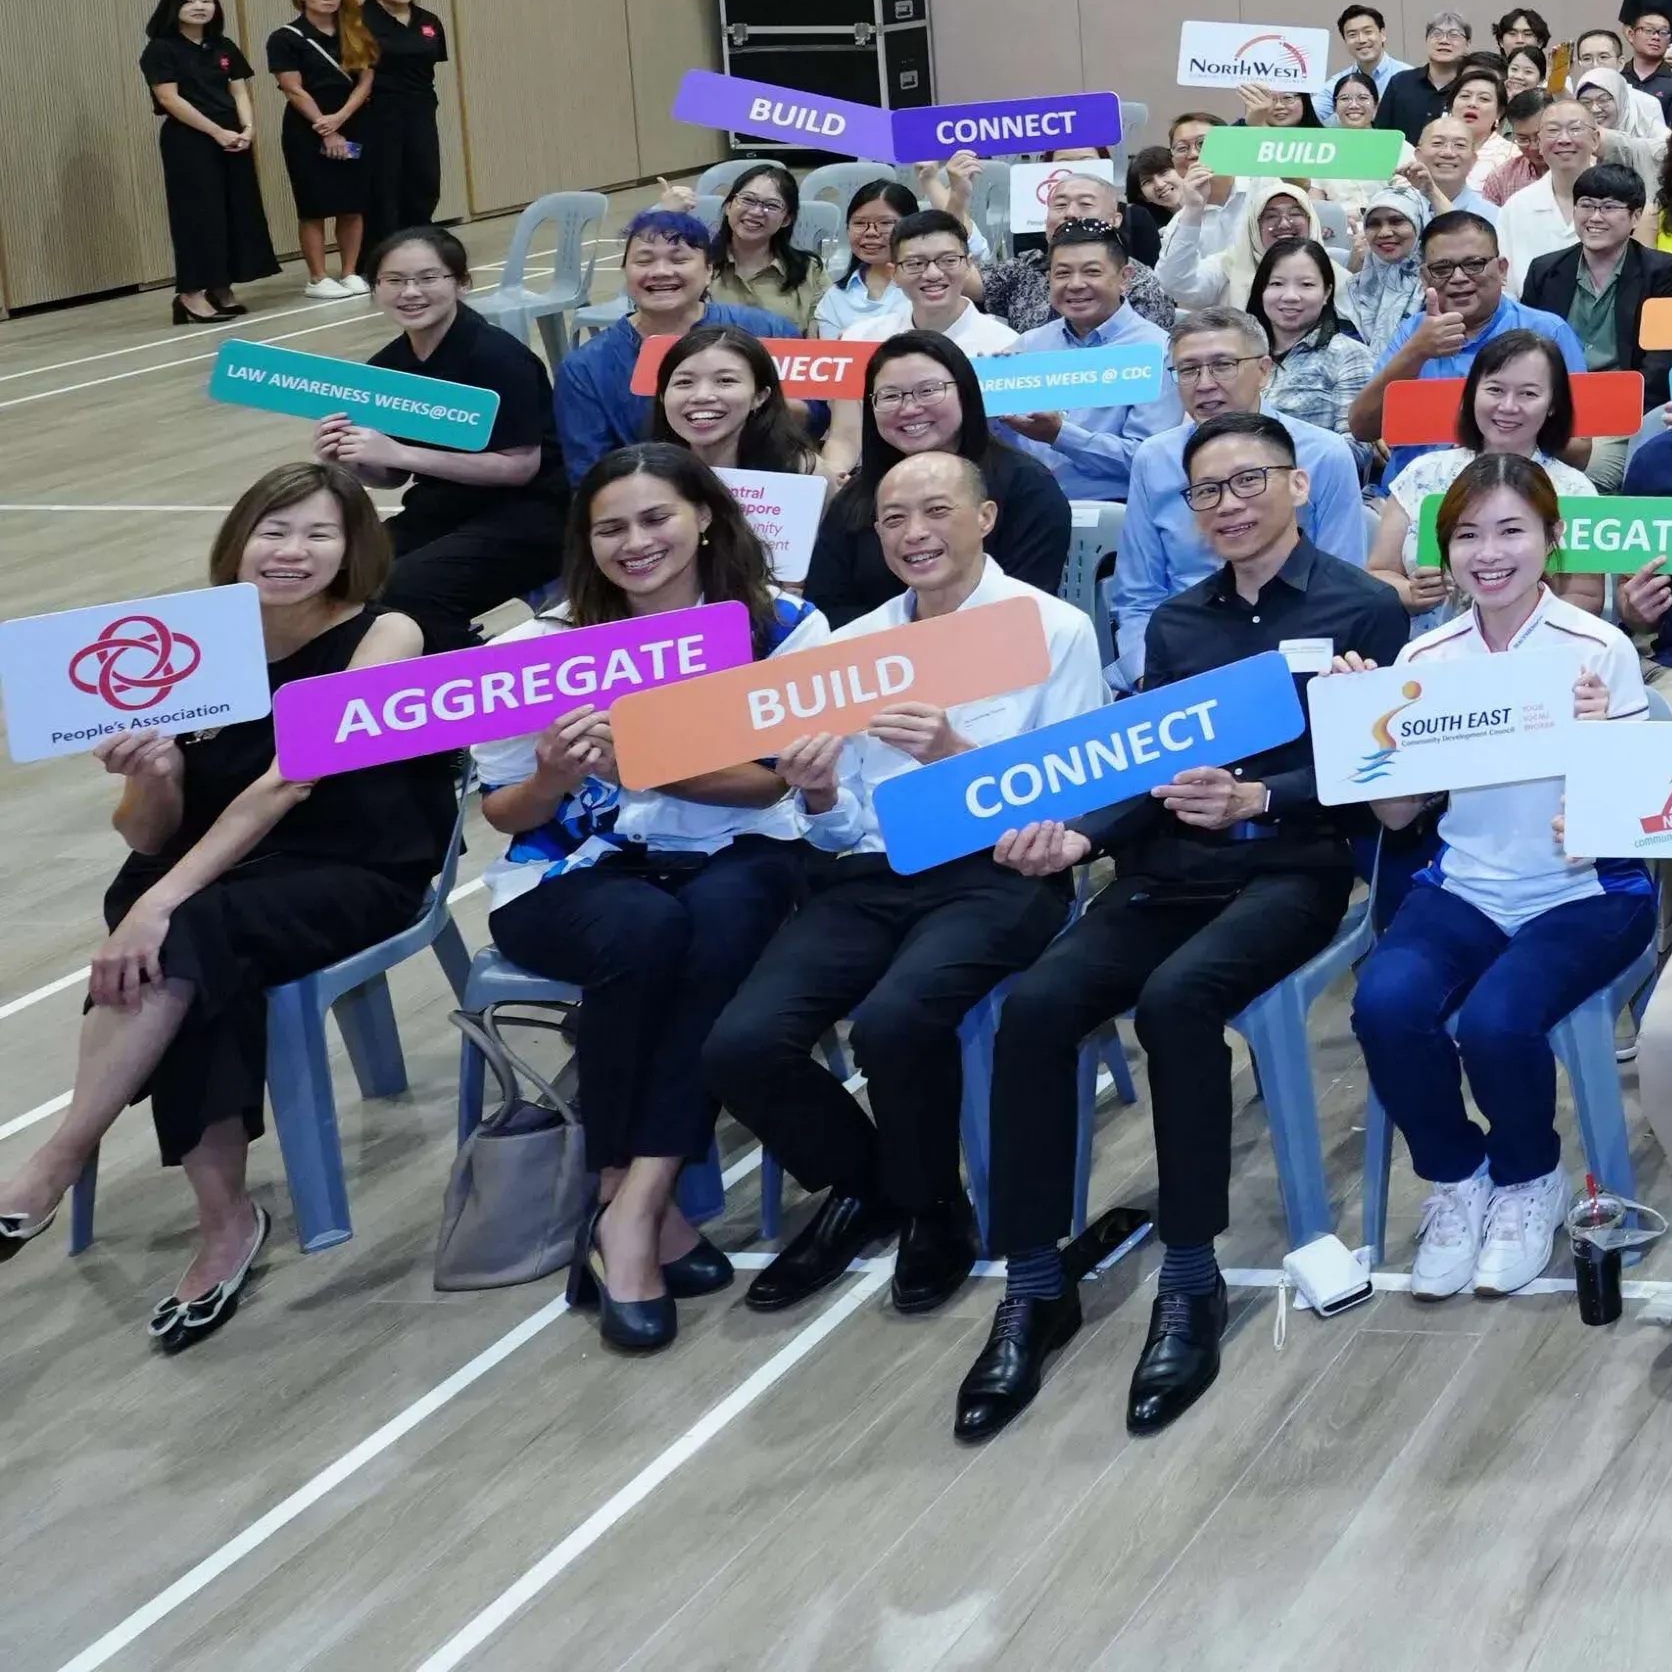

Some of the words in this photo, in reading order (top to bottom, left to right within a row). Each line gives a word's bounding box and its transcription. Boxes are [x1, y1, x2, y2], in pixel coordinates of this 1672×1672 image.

[749, 98, 847, 136] BUILD
[936, 110, 1077, 145] CONNECT
[1257, 141, 1336, 164] BUILD
[227, 364, 266, 383] LAW
[268, 373, 370, 404] AWARENESS
[375, 393, 481, 426] WEEKS@CDC
[1046, 371, 1098, 386] WEEKS
[1102, 369, 1117, 384] @
[1122, 366, 1152, 381] CDC
[334, 634, 707, 744] AGGREGATE
[746, 654, 916, 731] BUILD
[52, 720, 126, 743] People's
[130, 702, 230, 730] Association
[1401, 715, 1462, 737] SOUTH
[1467, 708, 1513, 729] EAST
[1401, 735, 1441, 747] Community
[1442, 730, 1488, 742] Development
[1489, 727, 1515, 736] Council
[965, 699, 1218, 818] CONNECT
